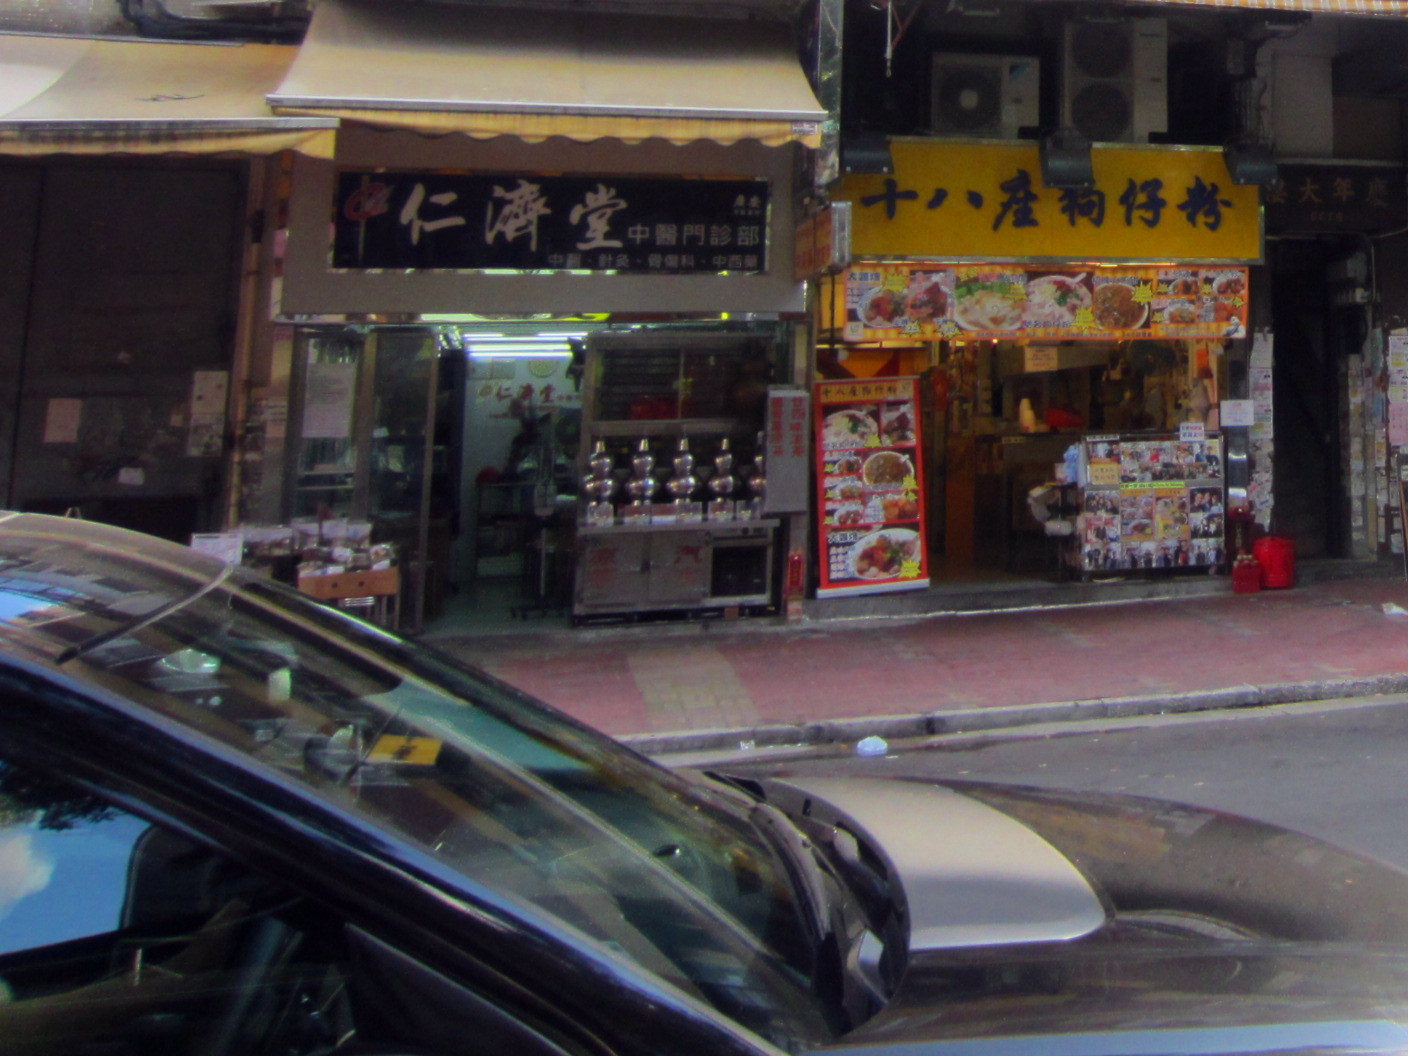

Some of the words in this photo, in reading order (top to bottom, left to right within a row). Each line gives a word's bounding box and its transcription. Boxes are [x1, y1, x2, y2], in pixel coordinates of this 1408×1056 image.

[400, 180, 628, 252] 仁濟堂
[860, 169, 1233, 231] 十八座狗仔粉
[627, 224, 760, 247] 中醫門診部
